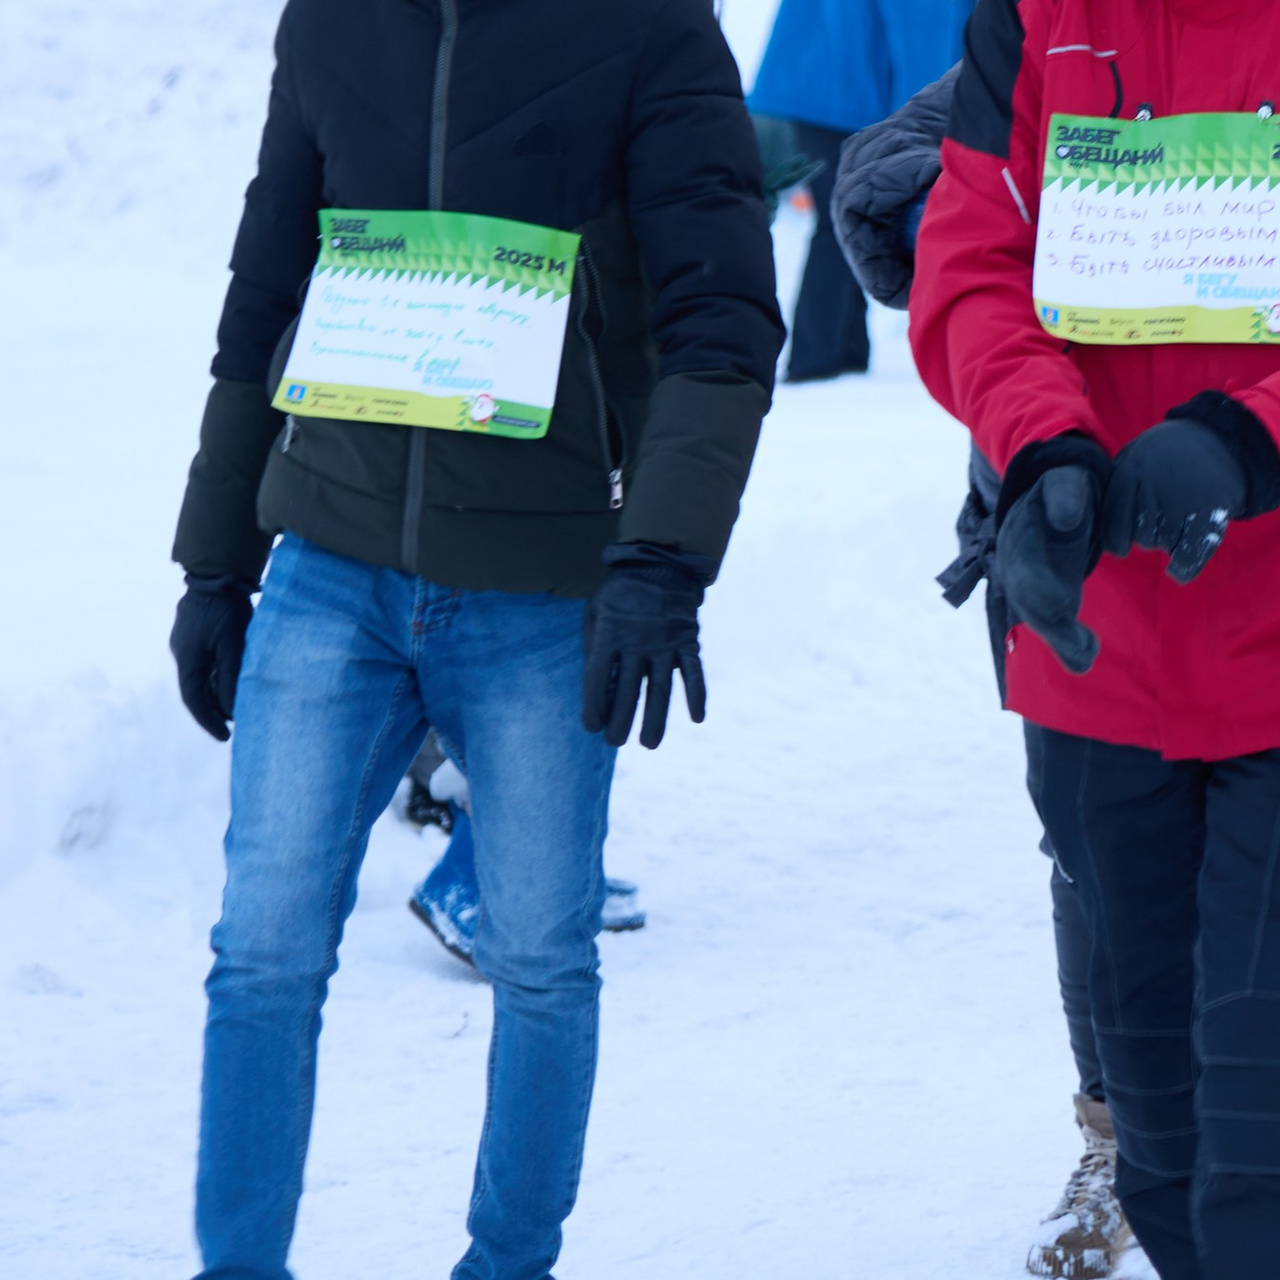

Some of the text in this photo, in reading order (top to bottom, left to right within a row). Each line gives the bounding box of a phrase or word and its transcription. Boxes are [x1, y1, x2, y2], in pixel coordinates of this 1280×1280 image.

[1056, 125, 1121, 146] ЗАБЕГ
[1055, 140, 1164, 169] ОБЕЩАНИЙ
[494, 246, 545, 270] 2025
